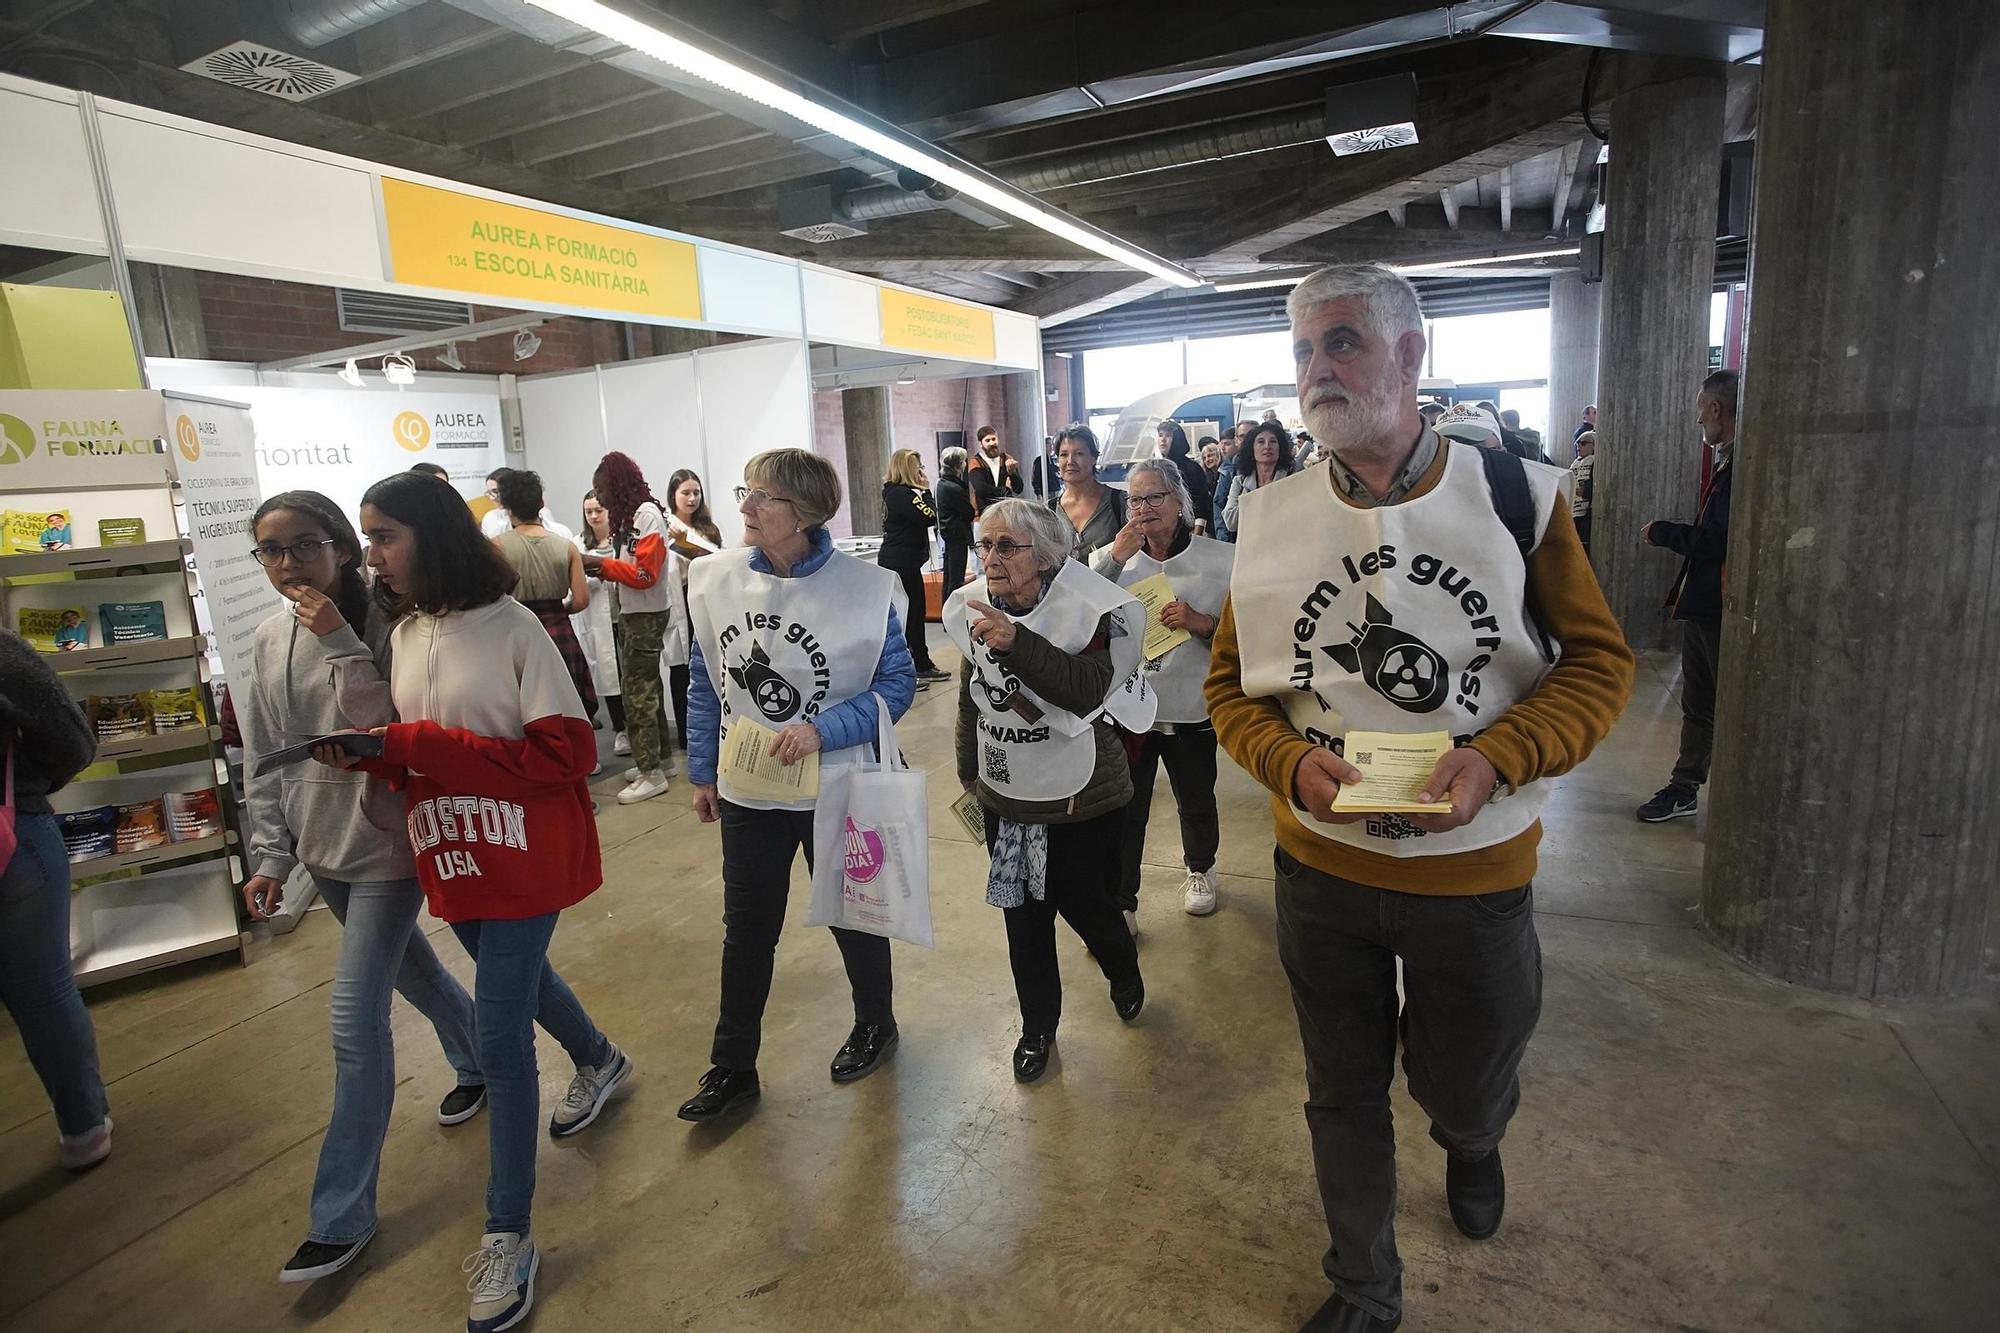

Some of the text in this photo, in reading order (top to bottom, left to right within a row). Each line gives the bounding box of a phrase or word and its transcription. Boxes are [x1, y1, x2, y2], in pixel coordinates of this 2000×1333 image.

[471, 220, 638, 269] AUREA FORMACIÓ
[447, 254, 468, 268] 134
[474, 250, 650, 297] ESCOLA SANITÀRIA
[42, 419, 125, 437] FAUNA
[435, 413, 487, 428] AUREA
[436, 429, 488, 441] FORMACIÓ
[255, 442, 353, 466] ioritat
[744, 611, 782, 632] les
[1341, 544, 1397, 585] les
[1406, 552, 1501, 717] guerres!
[434, 849, 483, 881] USA
[845, 853, 875, 870] DIA!
